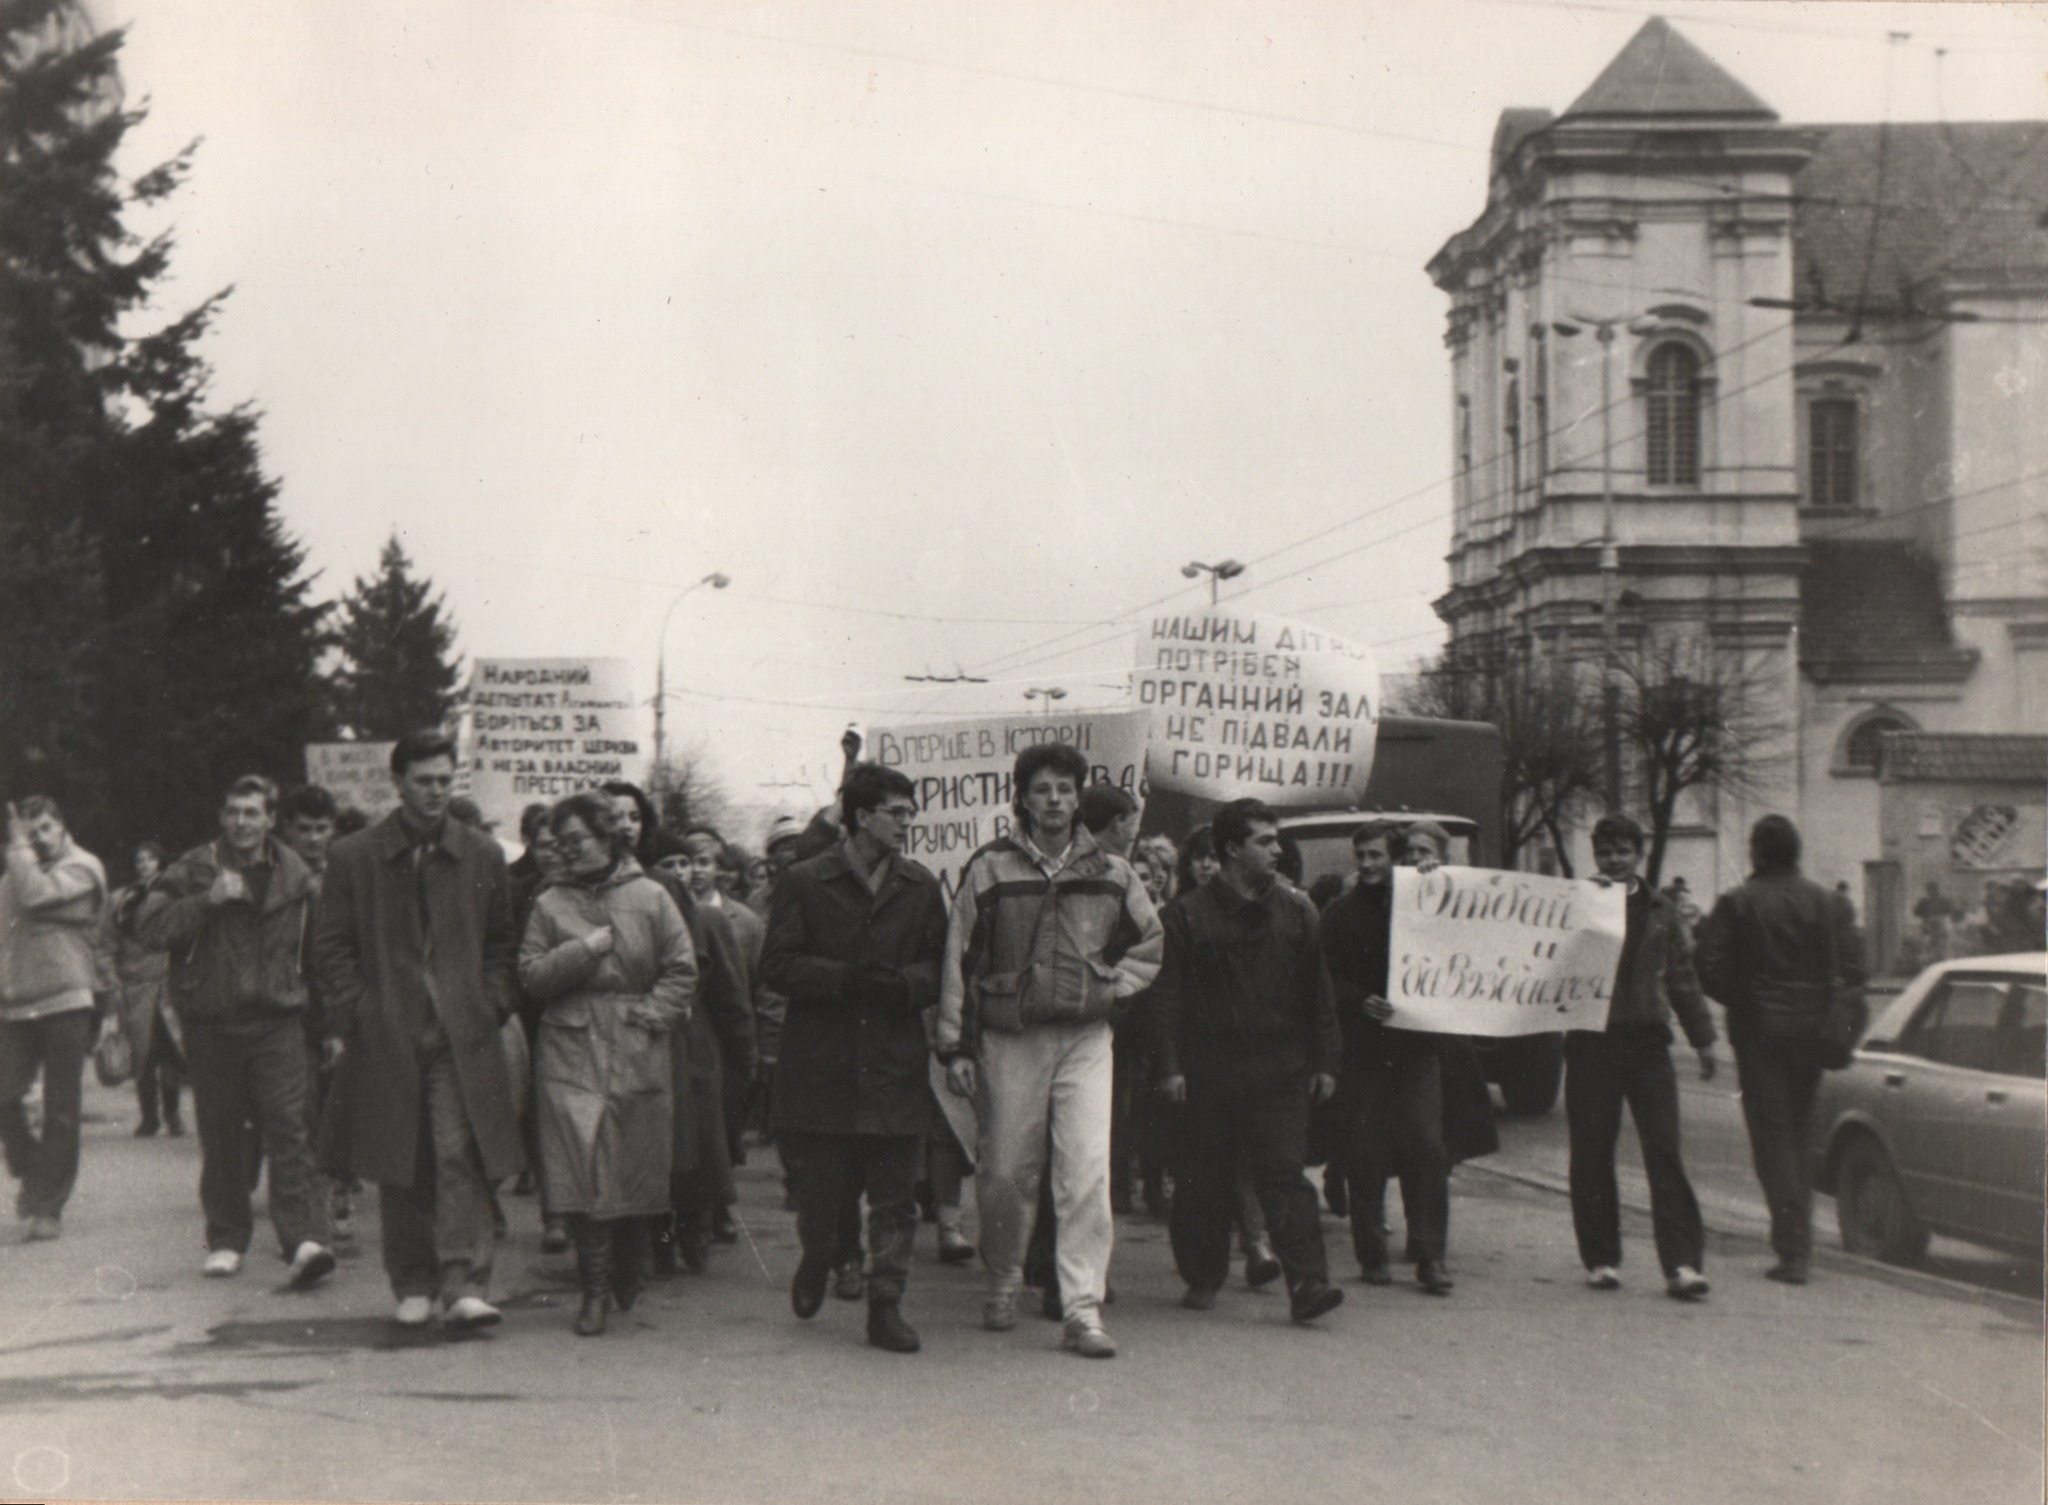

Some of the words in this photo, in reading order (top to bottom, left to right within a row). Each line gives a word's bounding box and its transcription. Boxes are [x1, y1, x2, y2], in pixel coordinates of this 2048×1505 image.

[1151, 617, 1256, 645] НАШИМ
[484, 665, 591, 685] НАРОДНИЙ
[1156, 647, 1301, 679] ПОТРІБЕН
[1140, 679, 1304, 714] ОРГАННИЙ
[573, 714, 601, 733] ЗА
[1166, 714, 1205, 742] НЕ
[1222, 719, 1352, 754] ПІДВАЛИ
[978, 729, 995, 758] В
[1172, 749, 1353, 788] ГОРИЩА!!!
[1532, 941, 1558, 960] и
